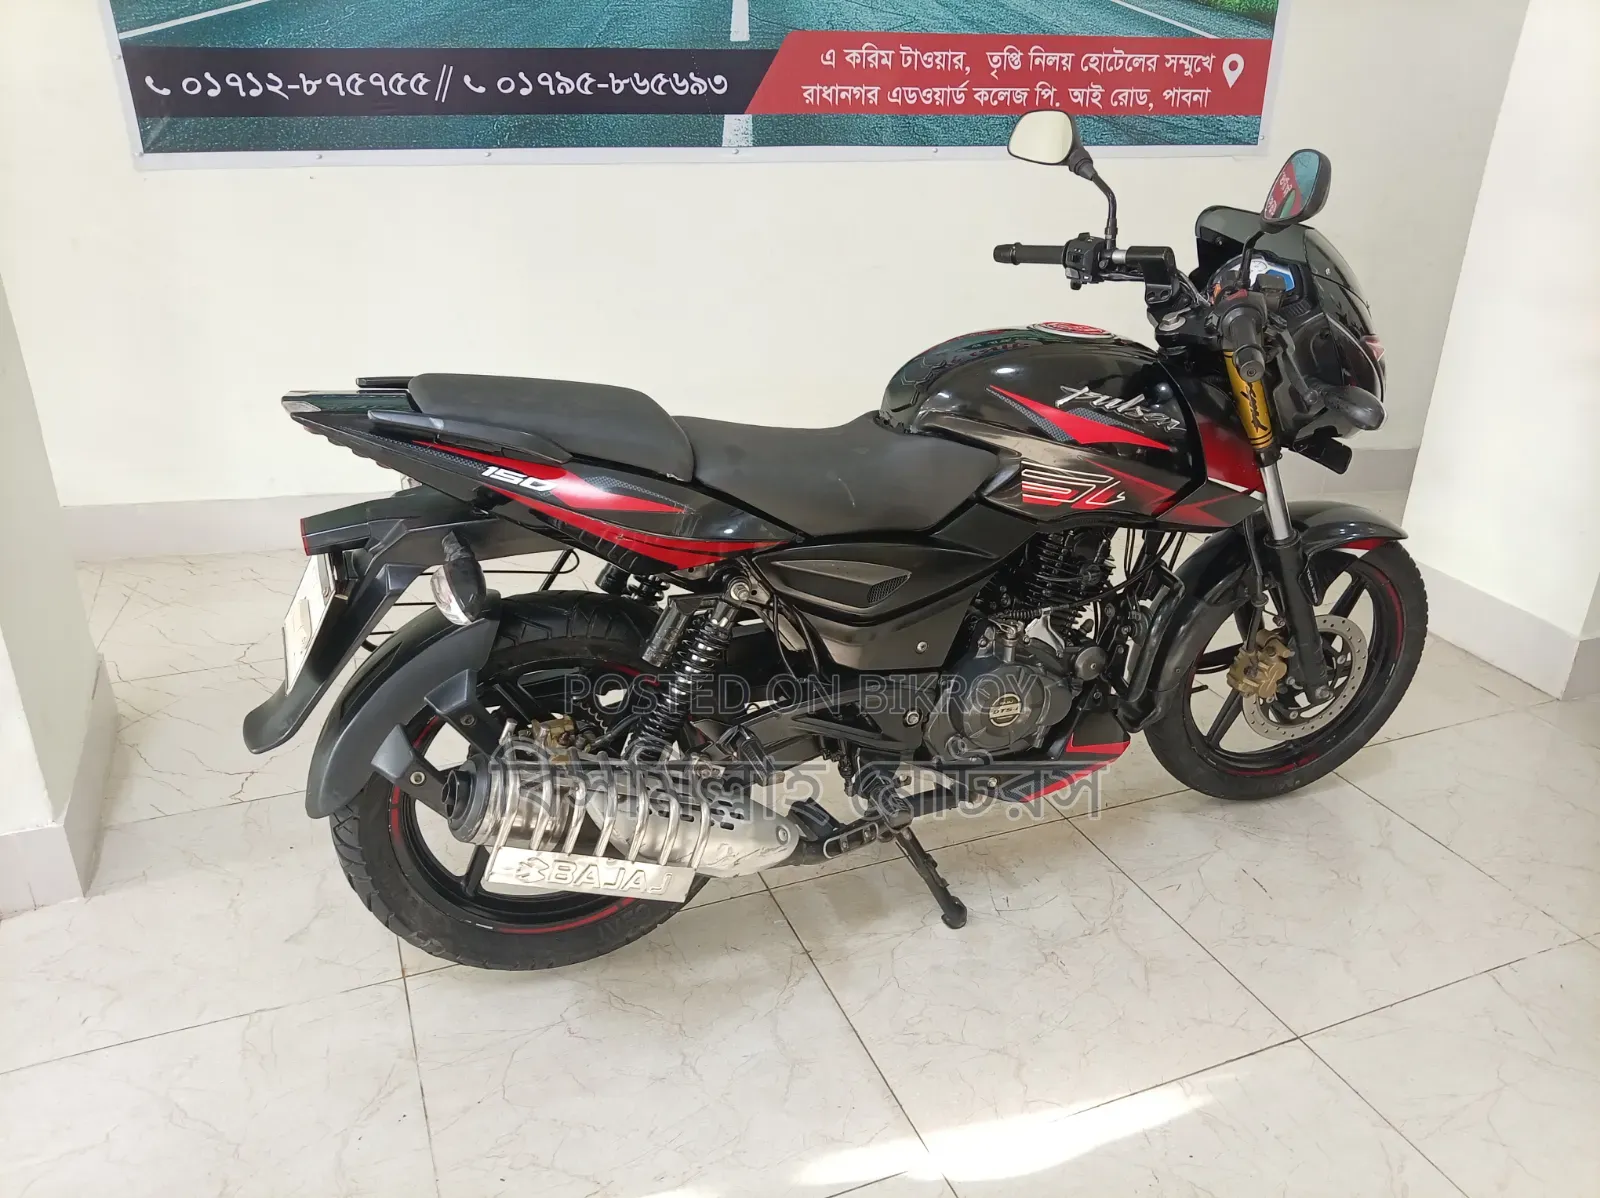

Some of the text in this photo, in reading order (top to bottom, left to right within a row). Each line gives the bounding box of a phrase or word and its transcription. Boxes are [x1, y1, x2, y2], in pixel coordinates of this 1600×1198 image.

[820, 42, 1216, 80] এ করিম টাওয়ার, তৃপ্তি নিলয় হোটেলের সম্মুখে
[496, 71, 728, 96] ০১৭৯৫-৮৬৫৬৯৩
[801, 80, 1212, 112] রাধানগর এডওয়ার্ড কলেজ পি. আই রোড, পাবনা
[481, 465, 558, 492] 150
[550, 859, 673, 895] BAJAJ
